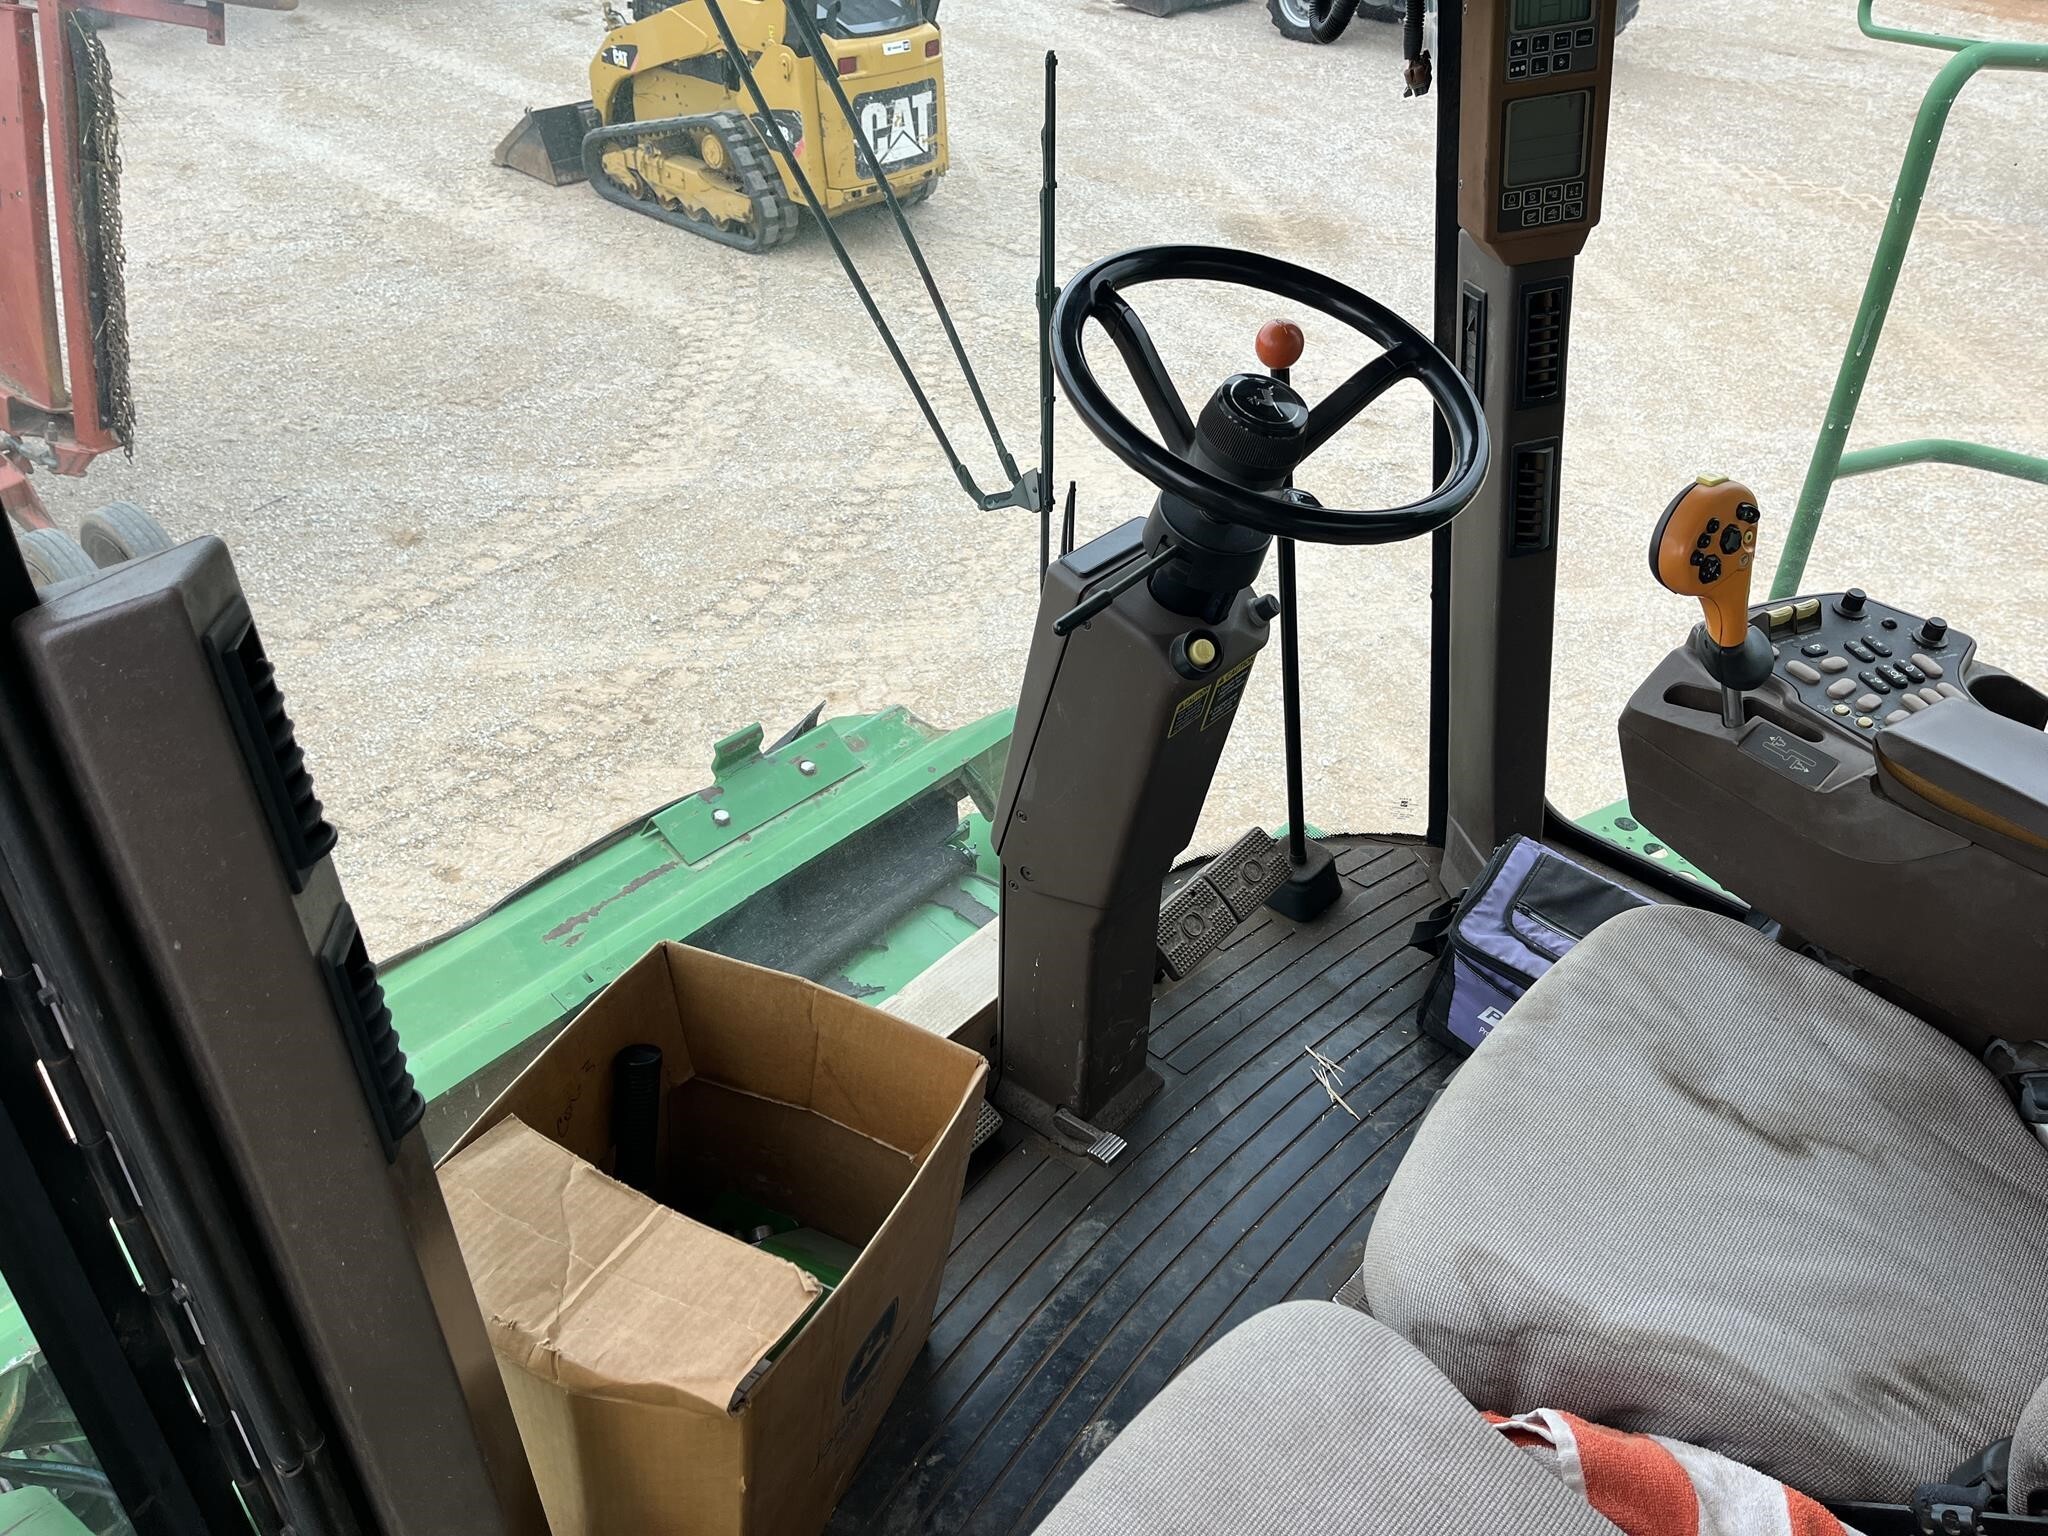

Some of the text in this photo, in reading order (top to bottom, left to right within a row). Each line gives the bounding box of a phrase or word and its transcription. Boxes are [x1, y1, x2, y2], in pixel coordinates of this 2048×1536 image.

[613, 48, 628, 67] CAT
[861, 90, 932, 163] CAT
[1486, 1010, 1503, 1021] P
